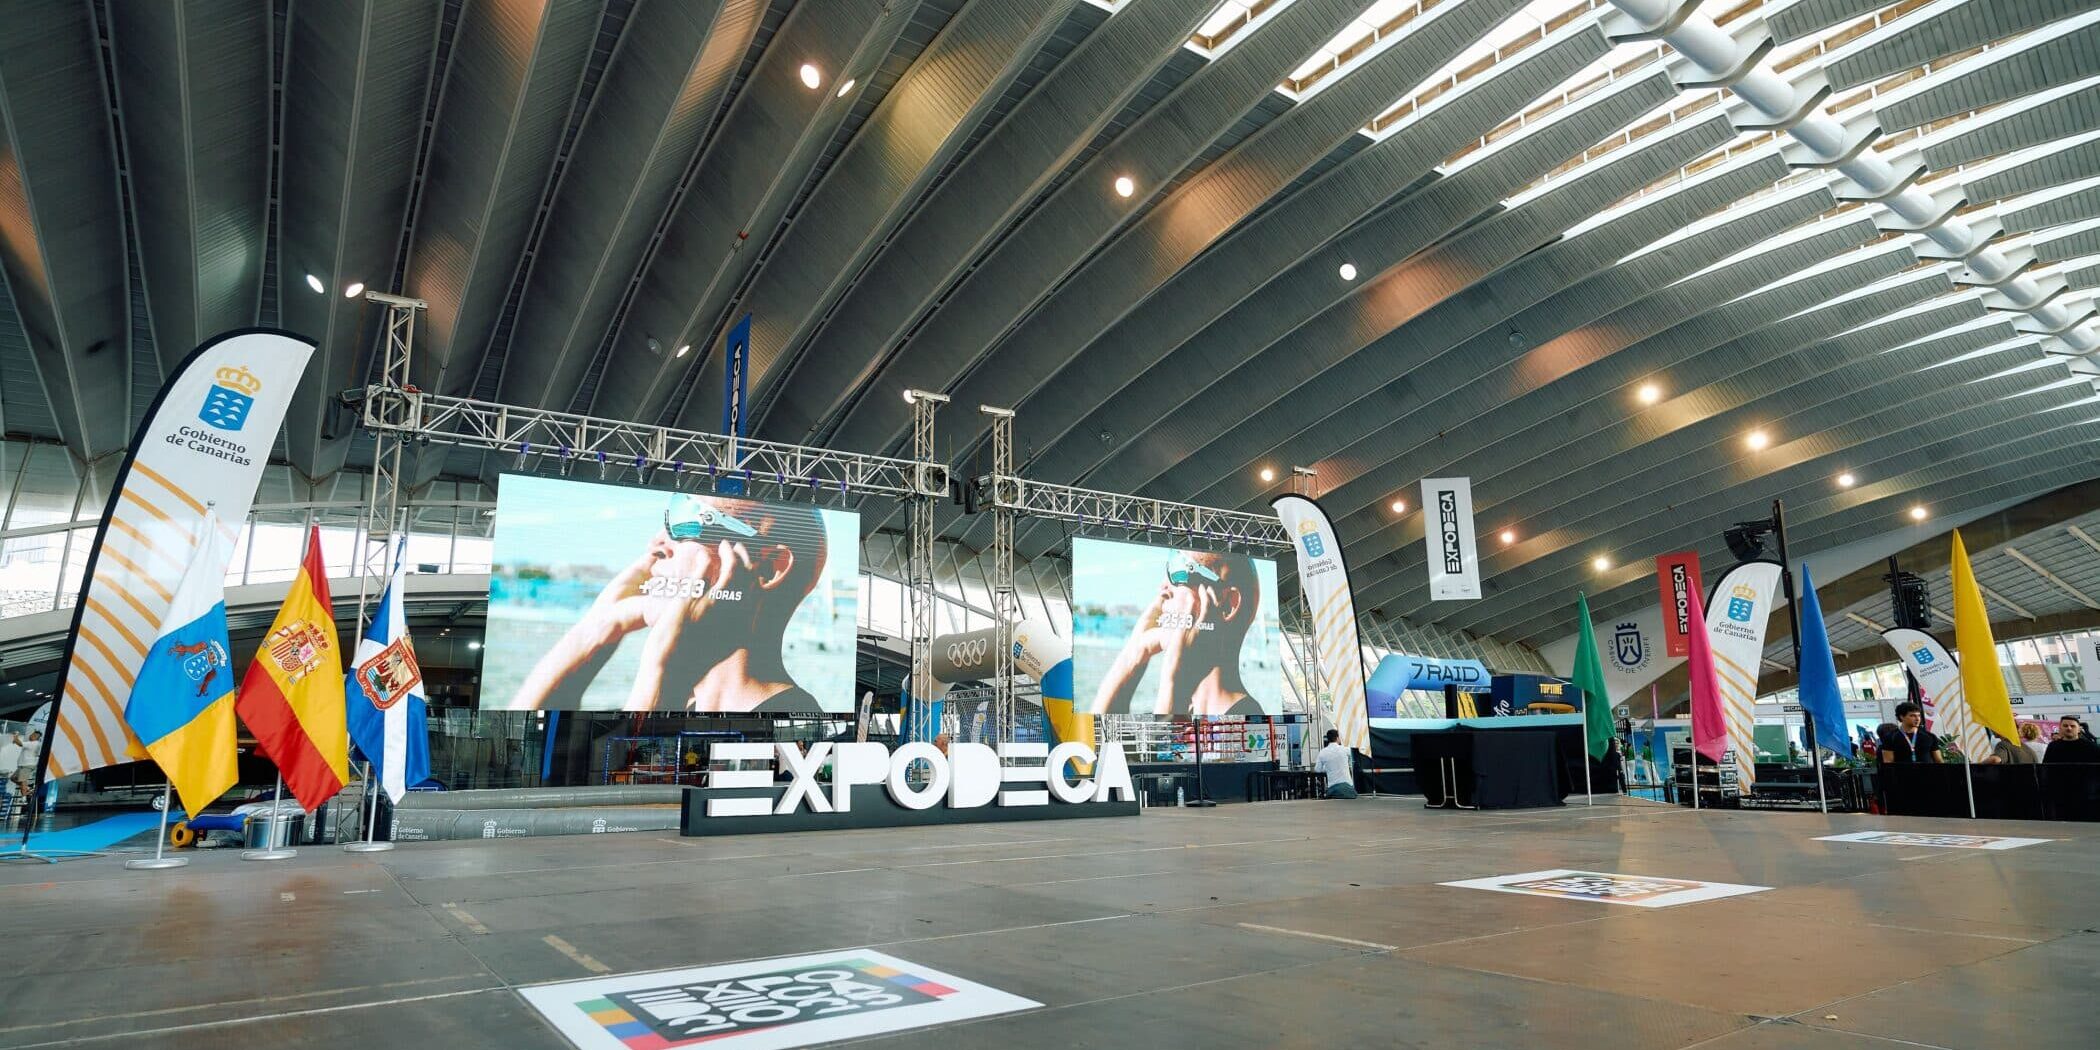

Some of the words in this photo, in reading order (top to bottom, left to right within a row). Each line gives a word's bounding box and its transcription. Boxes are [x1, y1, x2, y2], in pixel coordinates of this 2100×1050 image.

[165, 433, 185, 446] de
[187, 440, 251, 466] Canarias
[180, 426, 246, 454] Gobierno
[1440, 492, 1460, 573] EXPODECA
[708, 590, 742, 601] HORAS
[1673, 565, 1688, 634] EXPODECA
[1719, 621, 1755, 634] Gobierno
[1724, 628, 1757, 642] Canarias
[1426, 664, 1480, 683] RAID
[707, 741, 1137, 817] EXPODECA
[626, 970, 854, 1004] EXPO
[638, 980, 885, 1020] DECA
[668, 991, 903, 1035] 2025
